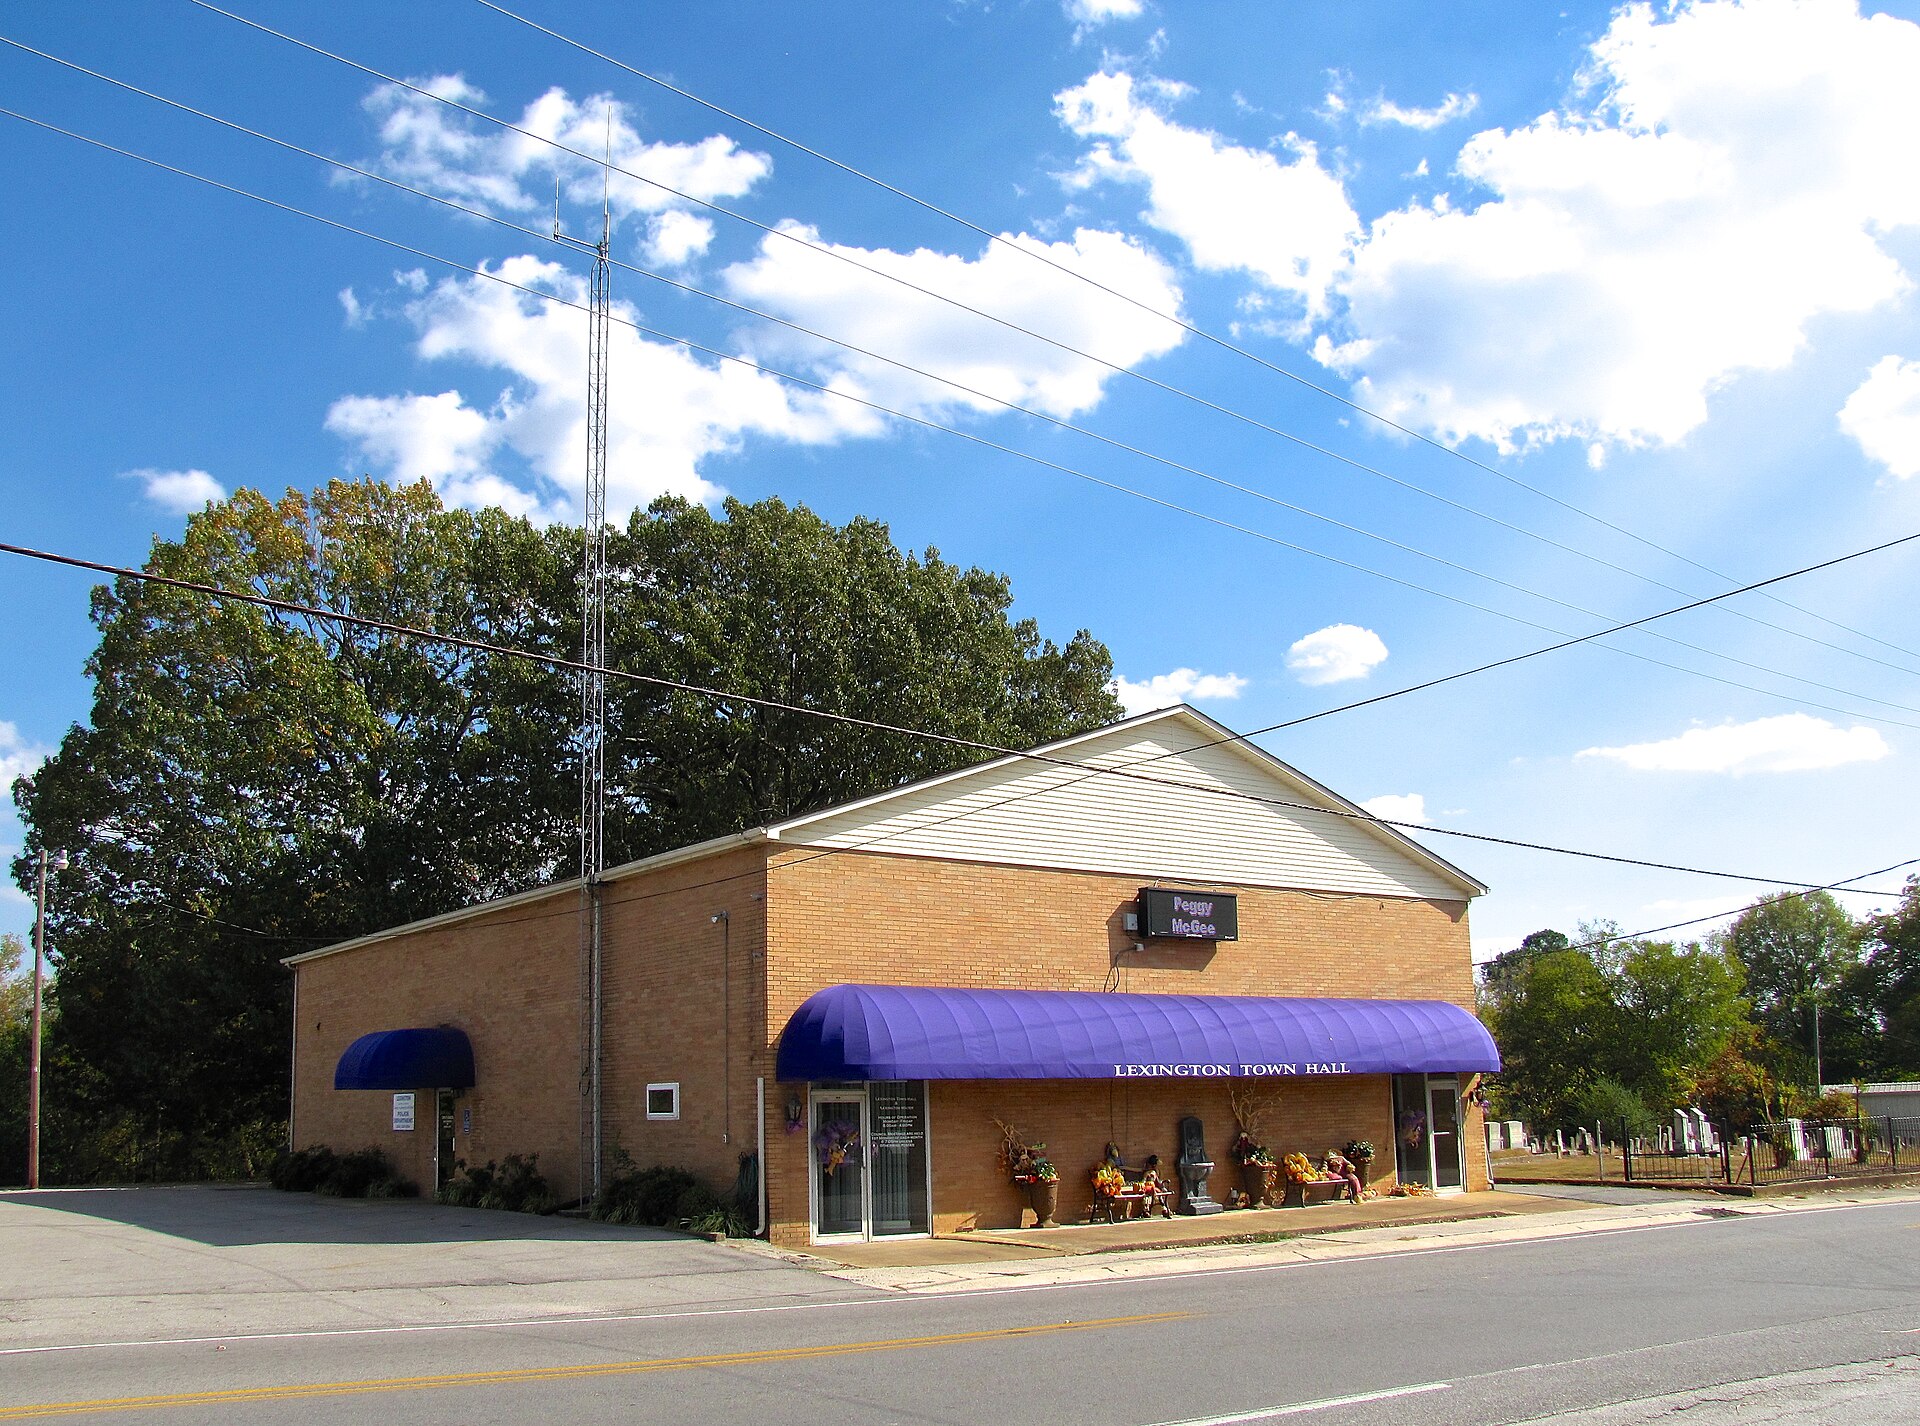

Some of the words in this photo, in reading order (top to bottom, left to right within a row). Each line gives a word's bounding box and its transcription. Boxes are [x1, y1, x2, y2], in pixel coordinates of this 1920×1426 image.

[1173, 896, 1214, 917] Peggy
[1171, 918, 1216, 935] McGee
[1114, 1064, 1231, 1077] LEXINGTON
[1240, 1064, 1297, 1076] TOWN
[1305, 1063, 1350, 1074] HALL
